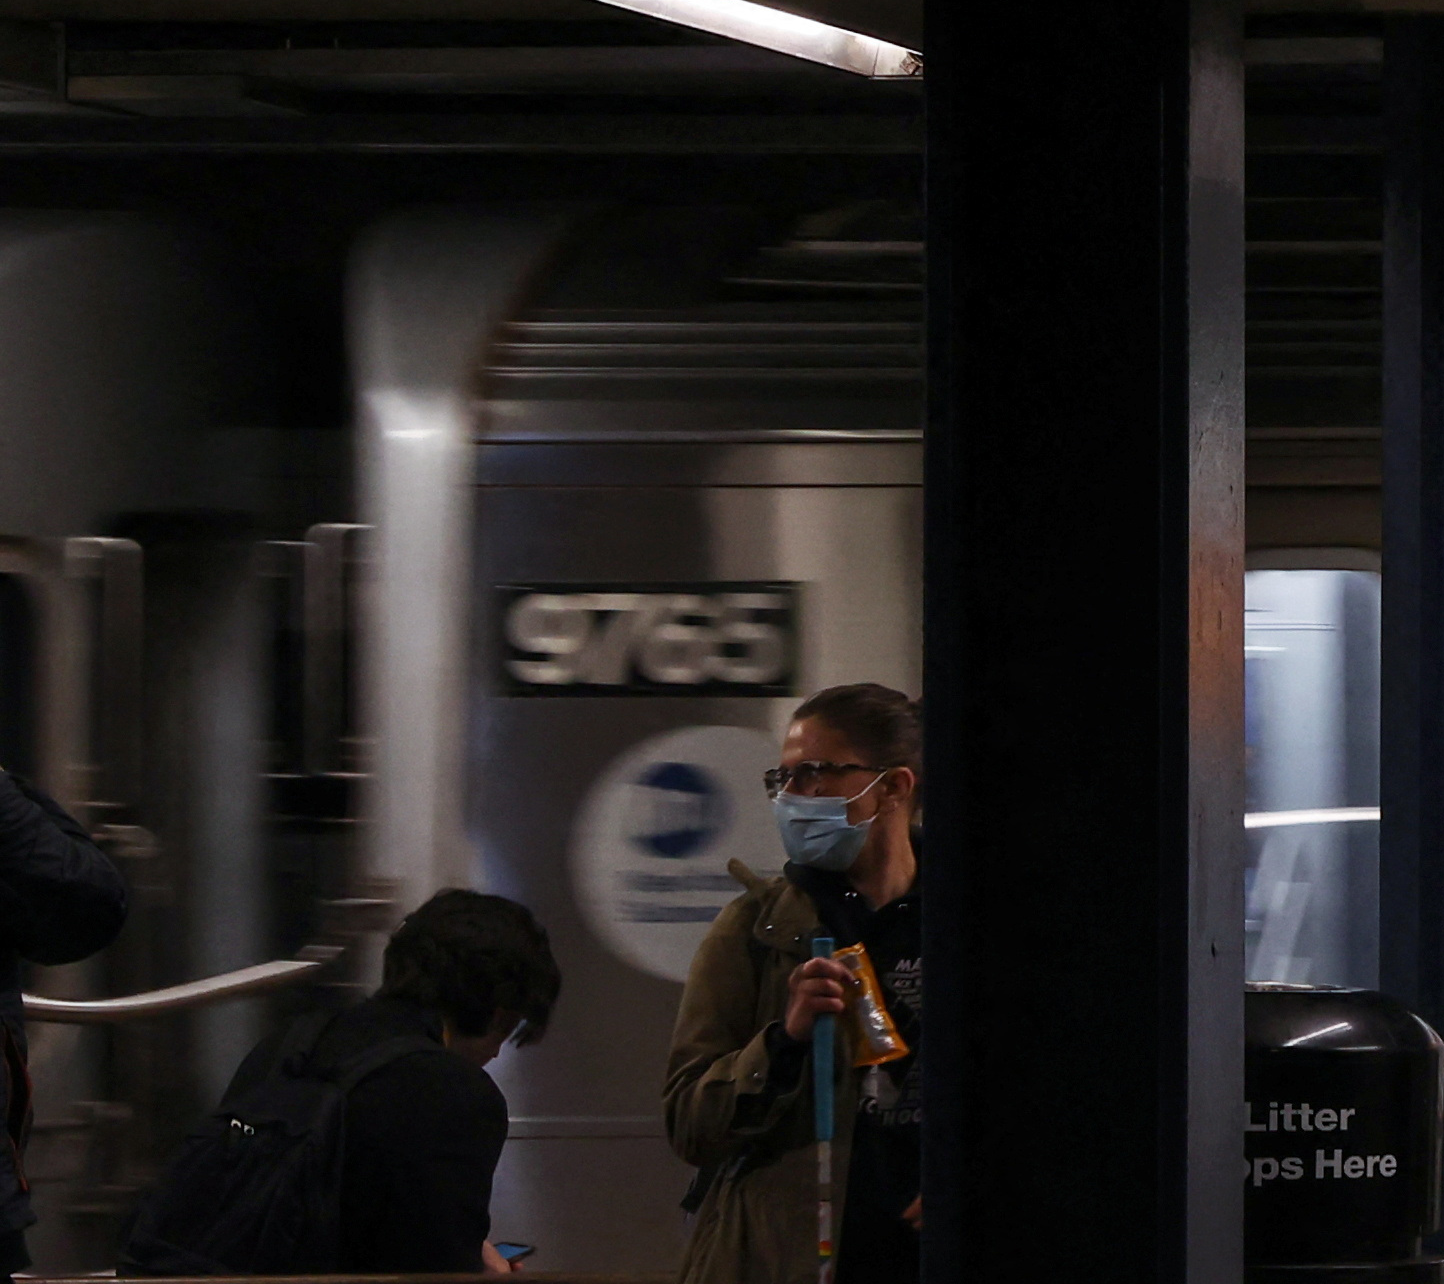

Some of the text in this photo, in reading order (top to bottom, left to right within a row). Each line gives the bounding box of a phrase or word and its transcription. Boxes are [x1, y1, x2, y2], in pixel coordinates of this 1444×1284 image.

[503, 593, 786, 685] 9765
[1244, 1101, 1356, 1132] Litter
[1315, 1148, 1398, 1179] Here
